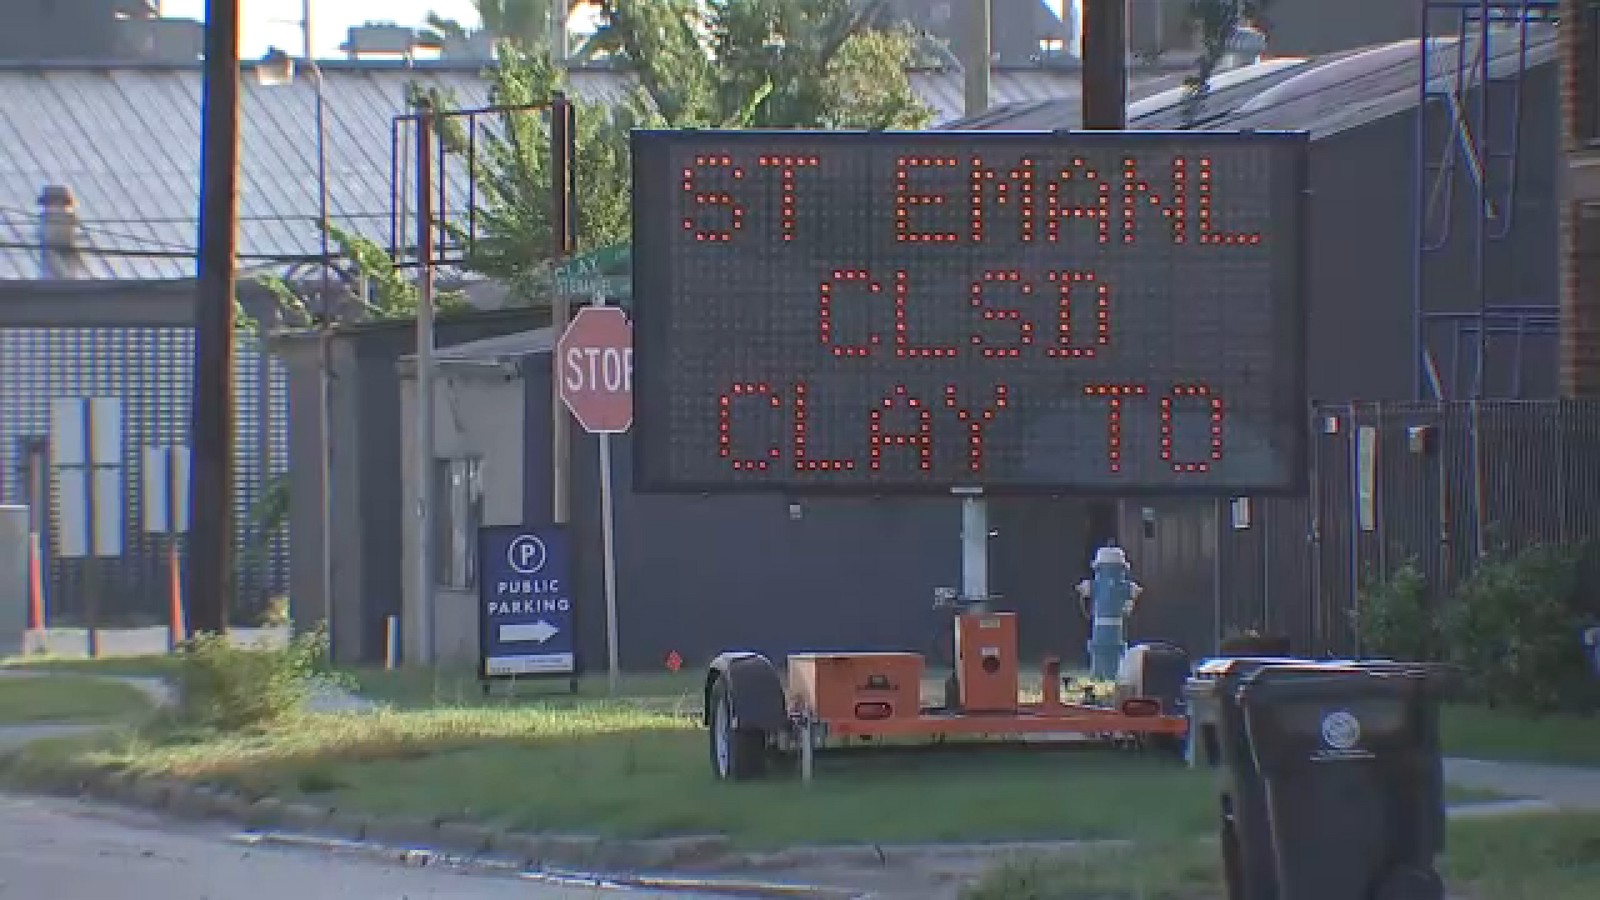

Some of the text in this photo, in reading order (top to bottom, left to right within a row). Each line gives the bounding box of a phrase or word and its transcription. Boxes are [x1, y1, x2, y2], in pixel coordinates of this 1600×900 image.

[681, 156, 1262, 245] ST EMANL
[820, 271, 1109, 358] CLSD
[719, 383, 1223, 474] CLAY TO
[520, 544, 536, 566] P
[487, 599, 571, 615] PARKING
[497, 579, 559, 595] PUBLIC
